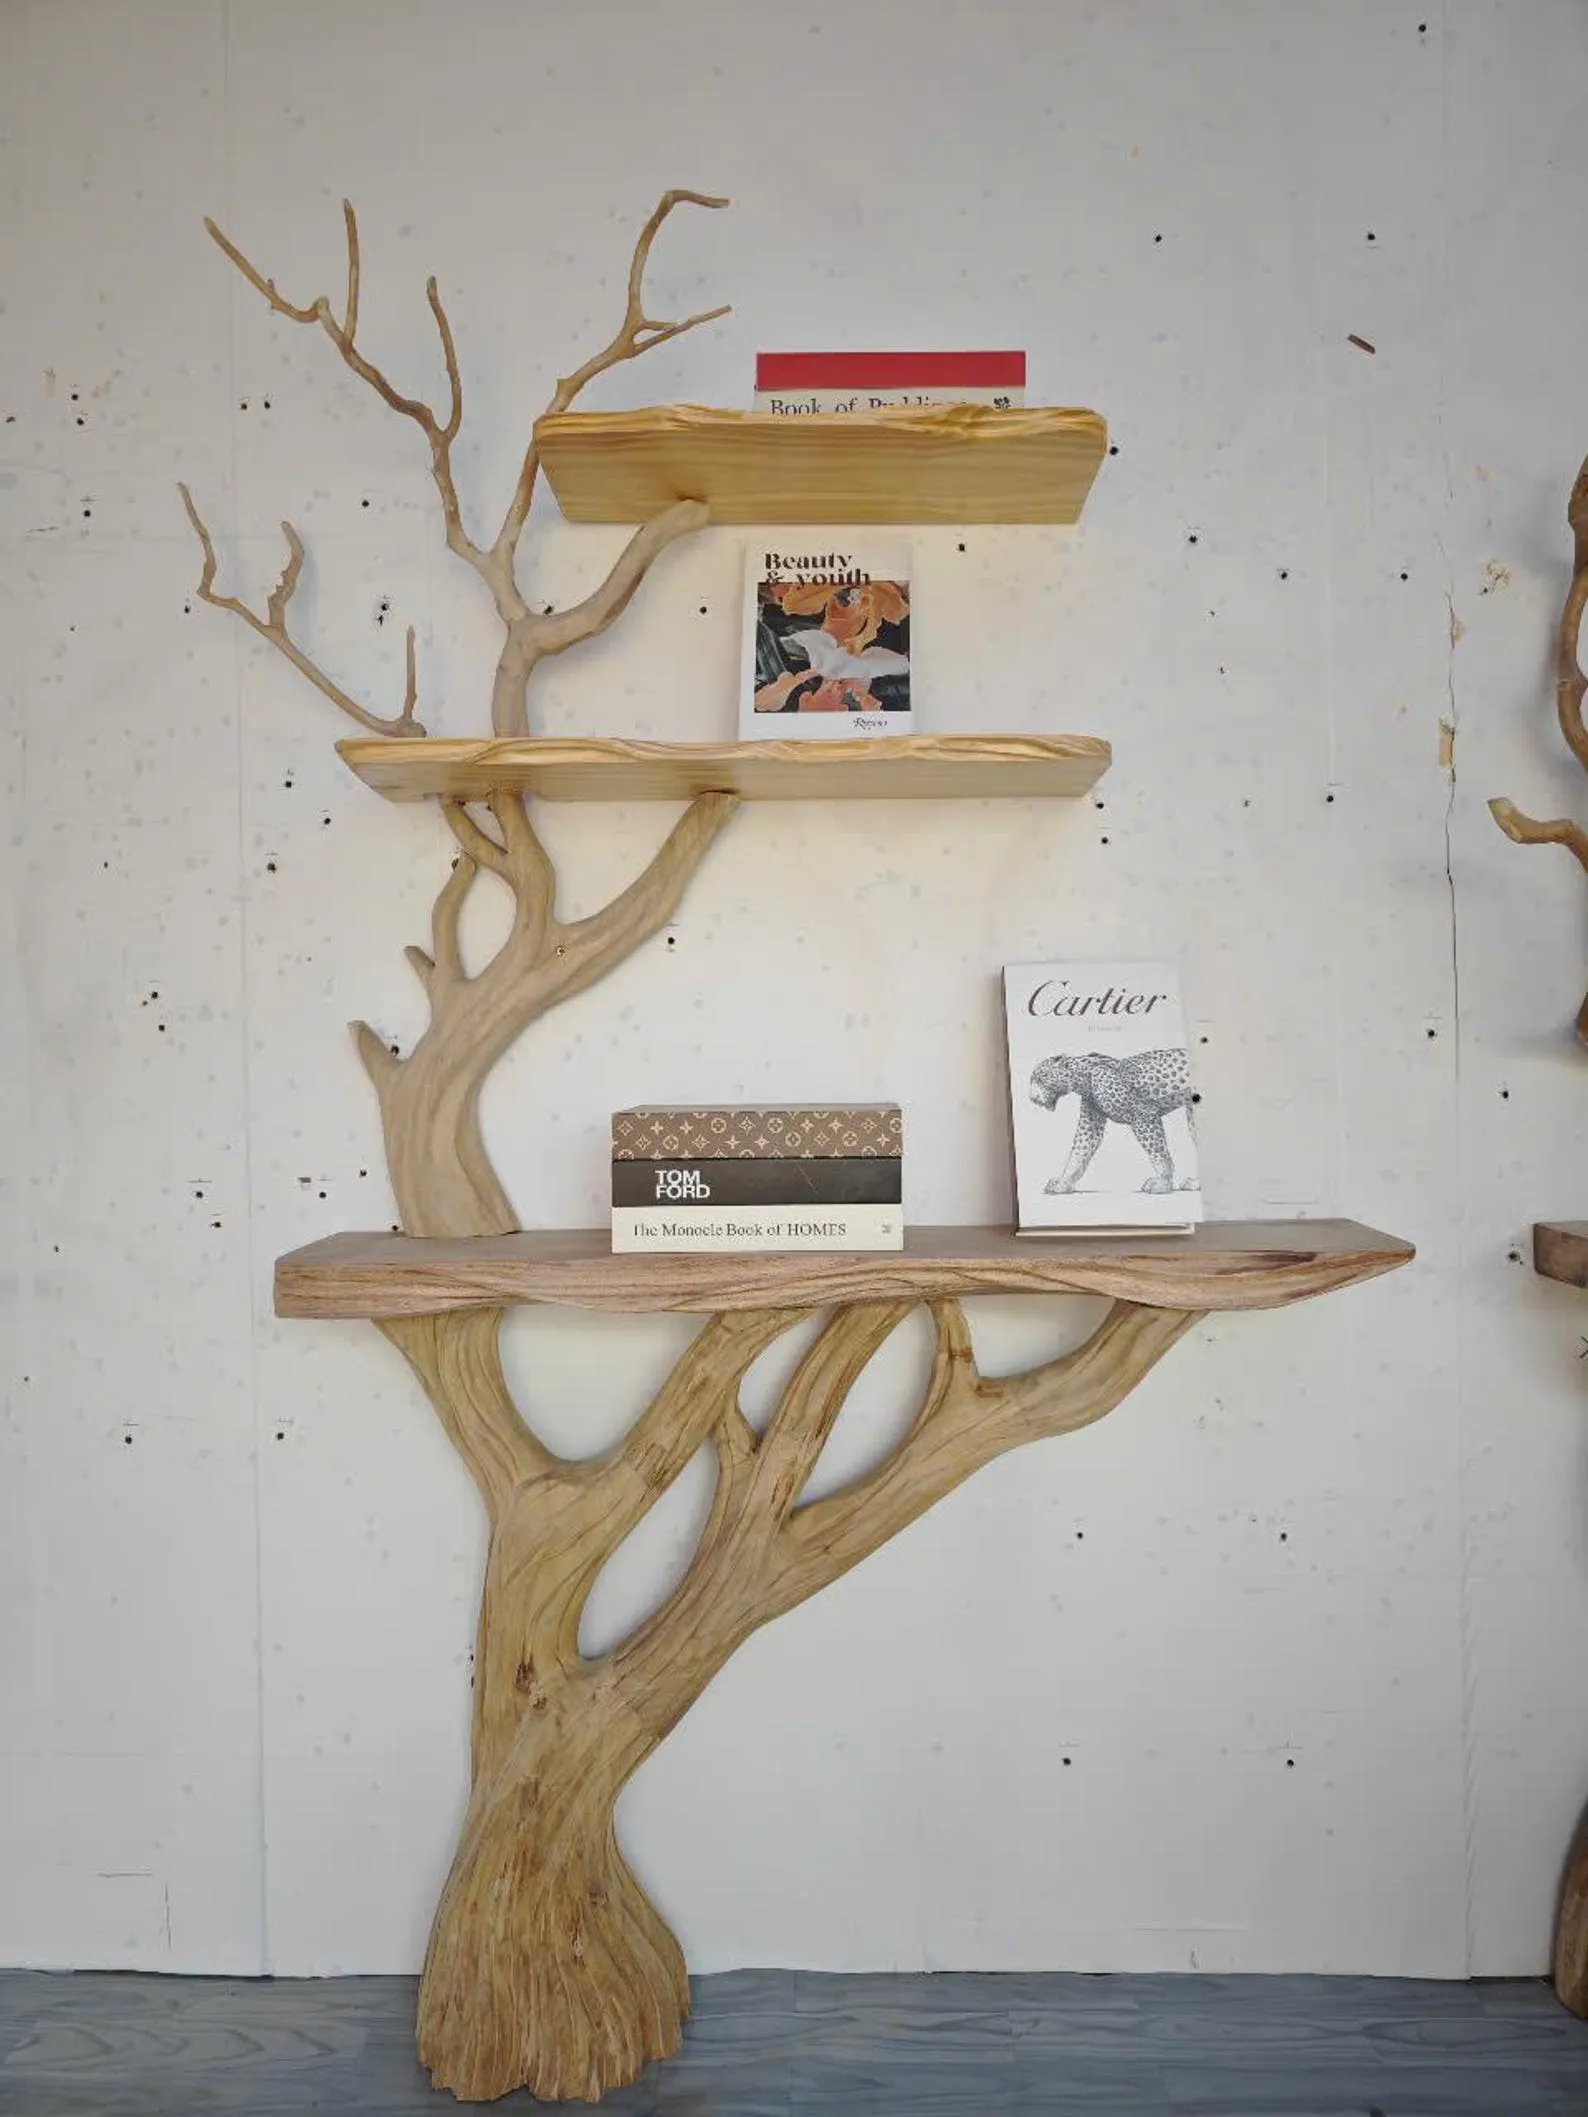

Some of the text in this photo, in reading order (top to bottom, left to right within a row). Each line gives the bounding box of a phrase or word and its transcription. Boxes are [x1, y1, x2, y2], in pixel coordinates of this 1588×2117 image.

[771, 398, 821, 414] Book
[835, 397, 858, 413] of
[765, 552, 852, 571] Beauty
[766, 568, 871, 590] & youth
[1027, 980, 1167, 1017] Cartier
[655, 1169, 700, 1185] TOM
[656, 1184, 711, 1199] FORD
[633, 1223, 846, 1236] The Monocle Book of HOMES
